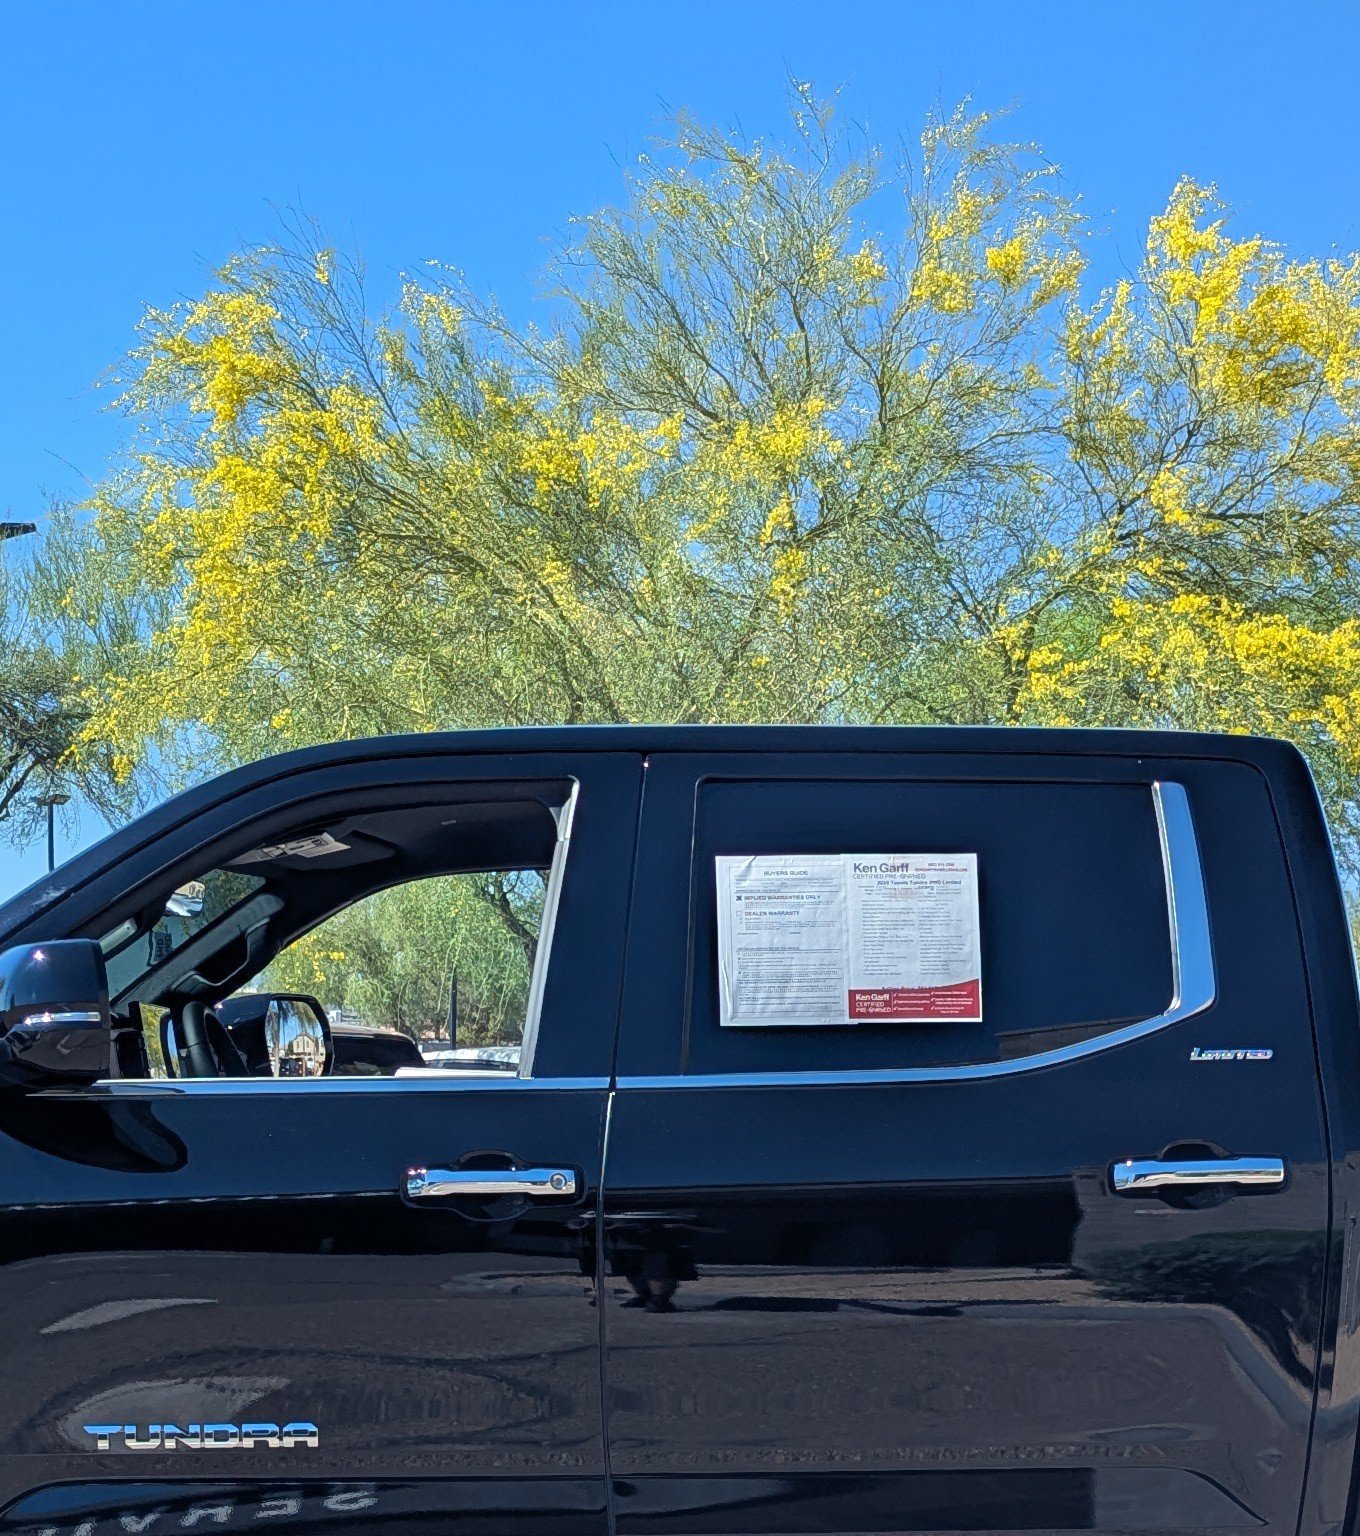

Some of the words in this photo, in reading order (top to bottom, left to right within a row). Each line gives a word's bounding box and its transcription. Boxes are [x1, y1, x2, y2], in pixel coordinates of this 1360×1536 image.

[853, 862, 878, 873] Ken
[879, 862, 910, 873] Garff
[855, 993, 871, 1001] Ken
[83, 1421, 319, 1451] TUNDRA
